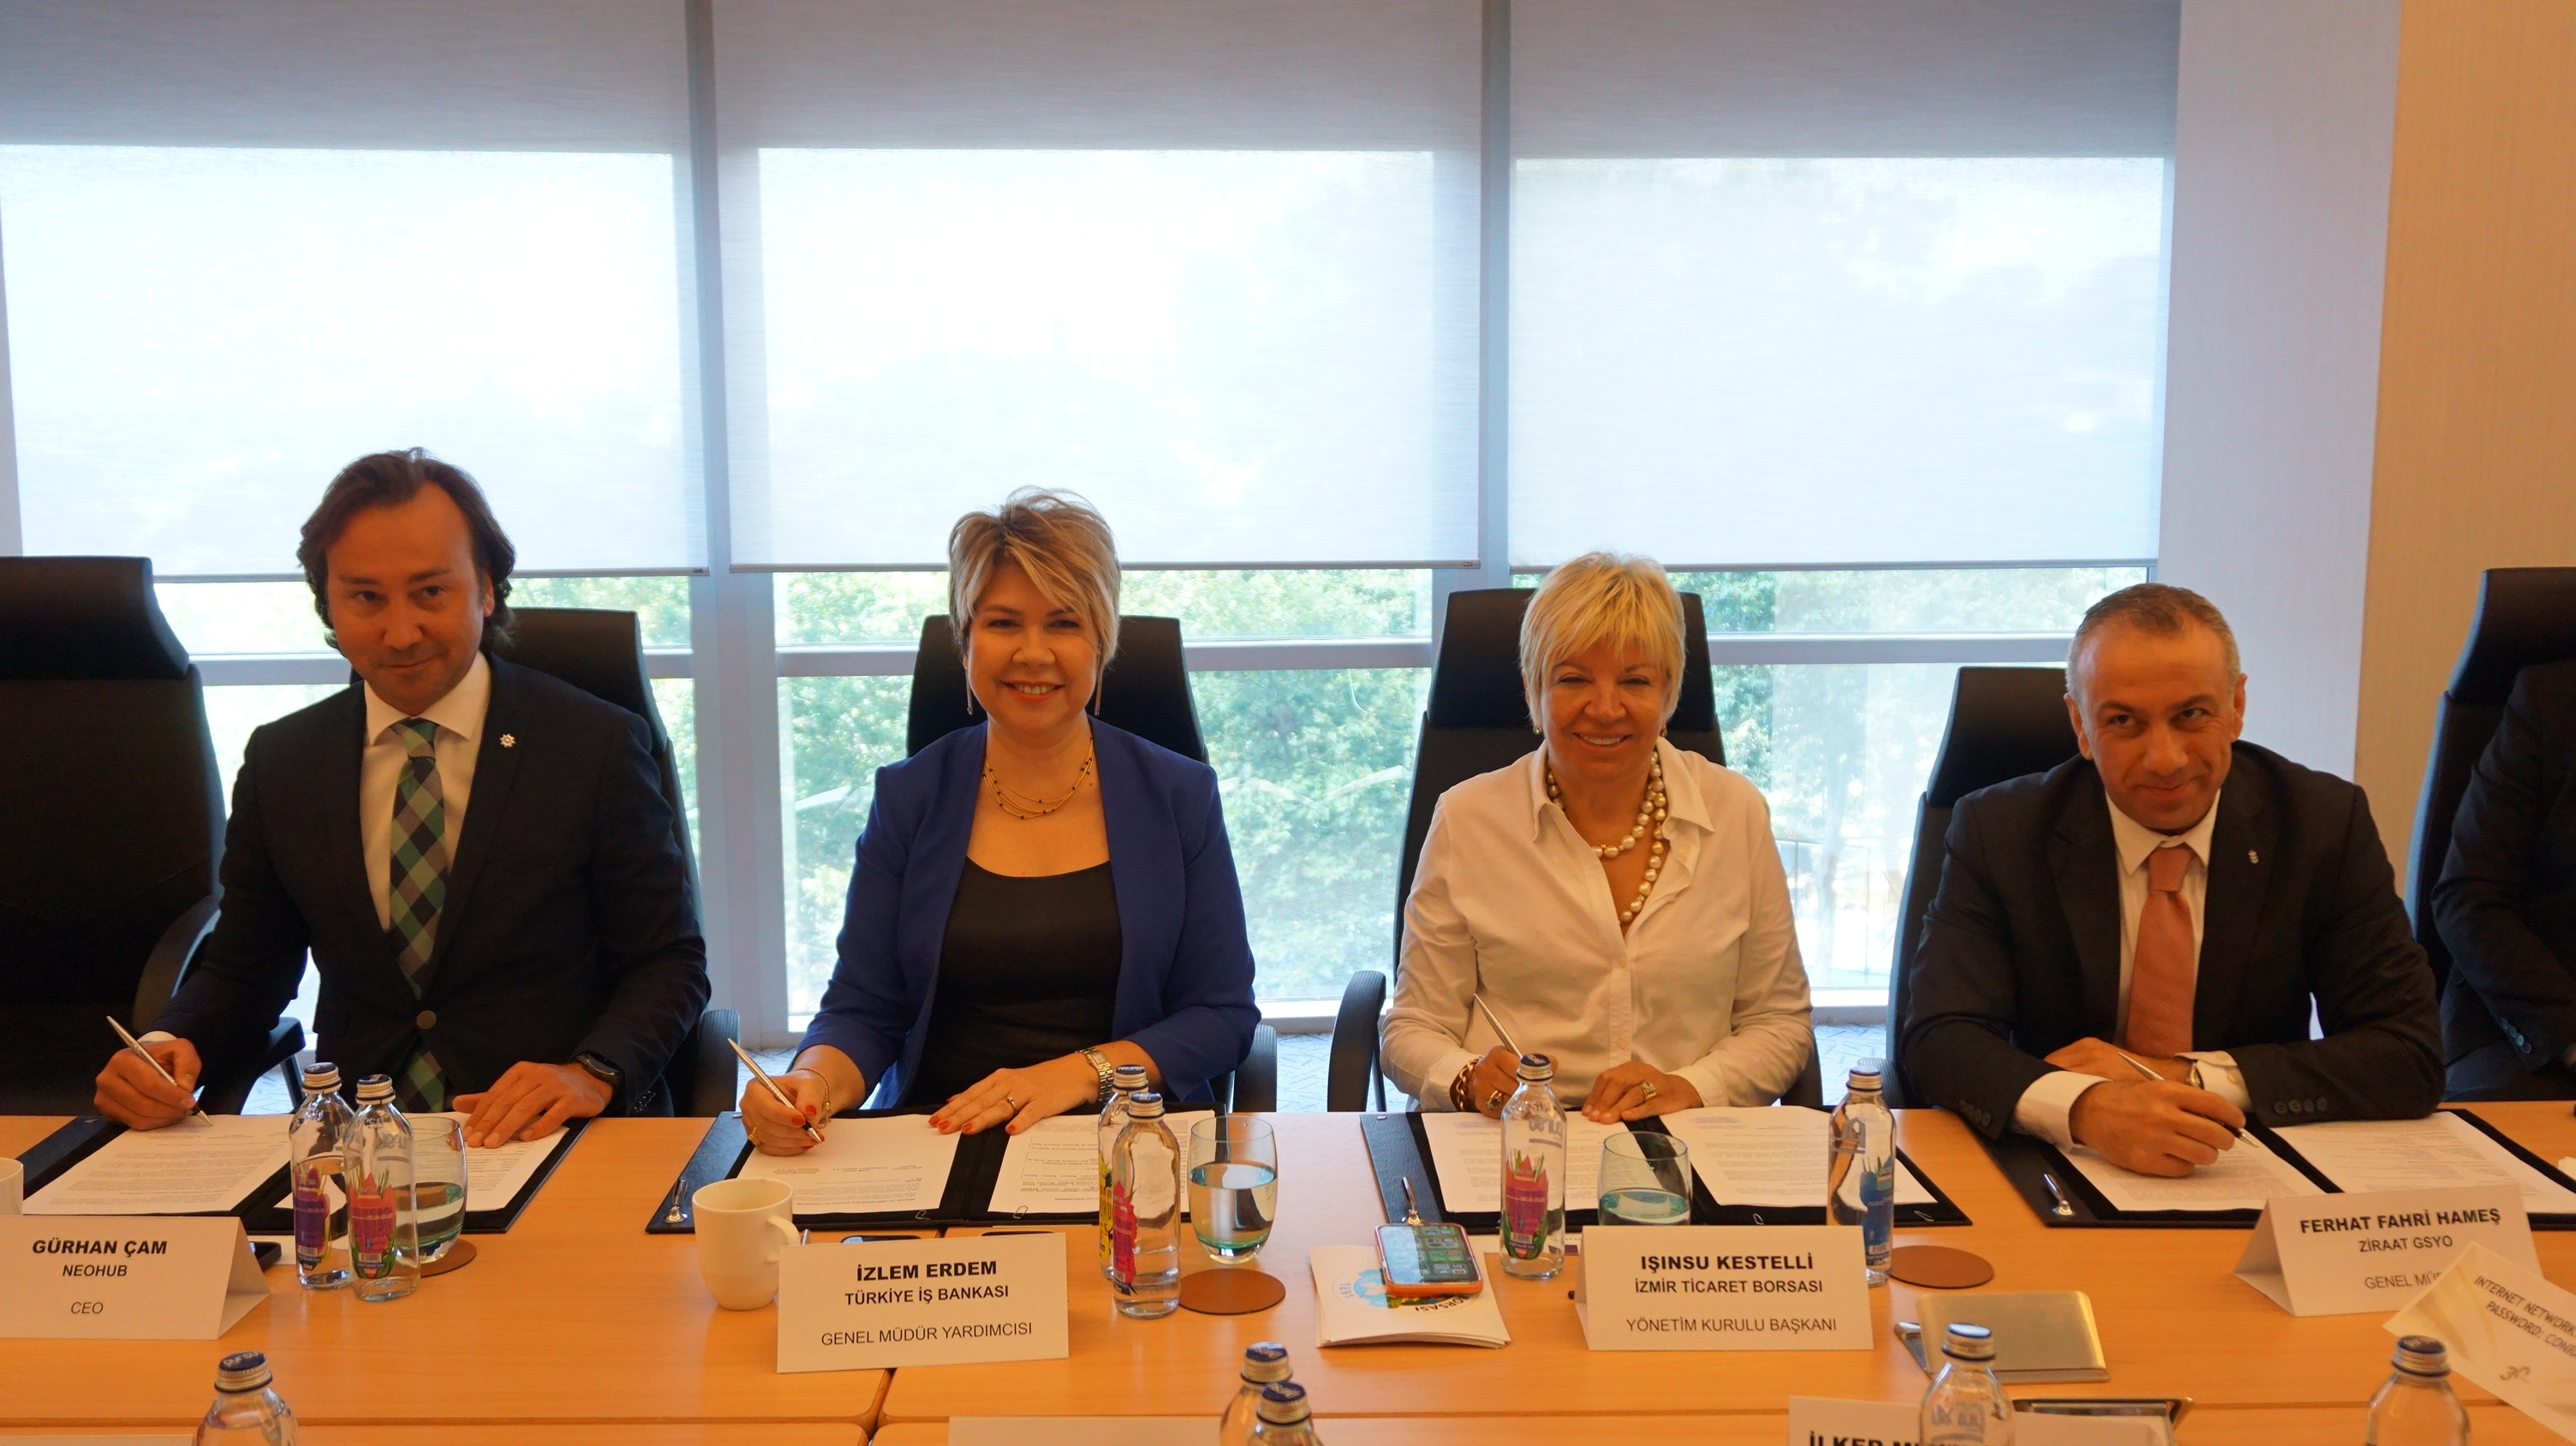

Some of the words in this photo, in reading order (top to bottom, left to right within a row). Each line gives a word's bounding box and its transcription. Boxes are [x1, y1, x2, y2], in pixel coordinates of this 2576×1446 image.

[2300, 1216, 2370, 1234] FERHAT
[2377, 1209, 2431, 1229] FAHRİ
[2436, 1208, 2501, 1226] HAMEŞ
[33, 1237, 117, 1254] GÜRHAN
[124, 1240, 167, 1258] ÇAM
[2359, 1236, 2408, 1252] ZİRAAT
[2412, 1235, 2453, 1249] GSYO
[63, 1264, 128, 1276] NEOHUB
[856, 1264, 919, 1282] İZLEM
[926, 1260, 997, 1278] ERDEM
[1641, 1256, 1709, 1273] IŞINSU
[1716, 1252, 1813, 1270] KESTELLİ
[1635, 1277, 1678, 1293] İZMİR
[1681, 1277, 1748, 1293] TİCARET
[1753, 1280, 1822, 1294] BORSASI
[2365, 1273, 2412, 1289] GENEL
[2474, 1275, 2526, 1306] INTERNET
[844, 1288, 914, 1306] TÜRKİYE
[918, 1286, 933, 1305] İŞ
[938, 1285, 1009, 1300] BANKASI
[70, 1301, 104, 1314] CEO
[1626, 1316, 1697, 1331] YÖNETİM
[1702, 1318, 1765, 1331] KURULU
[1769, 1318, 1837, 1335] BAŞKANI
[2485, 1300, 2544, 1339] PASSWORD:
[821, 1330, 874, 1346] GENEL
[879, 1326, 938, 1342] MÜDÜR
[942, 1322, 1033, 1339] YARDIMCISI
